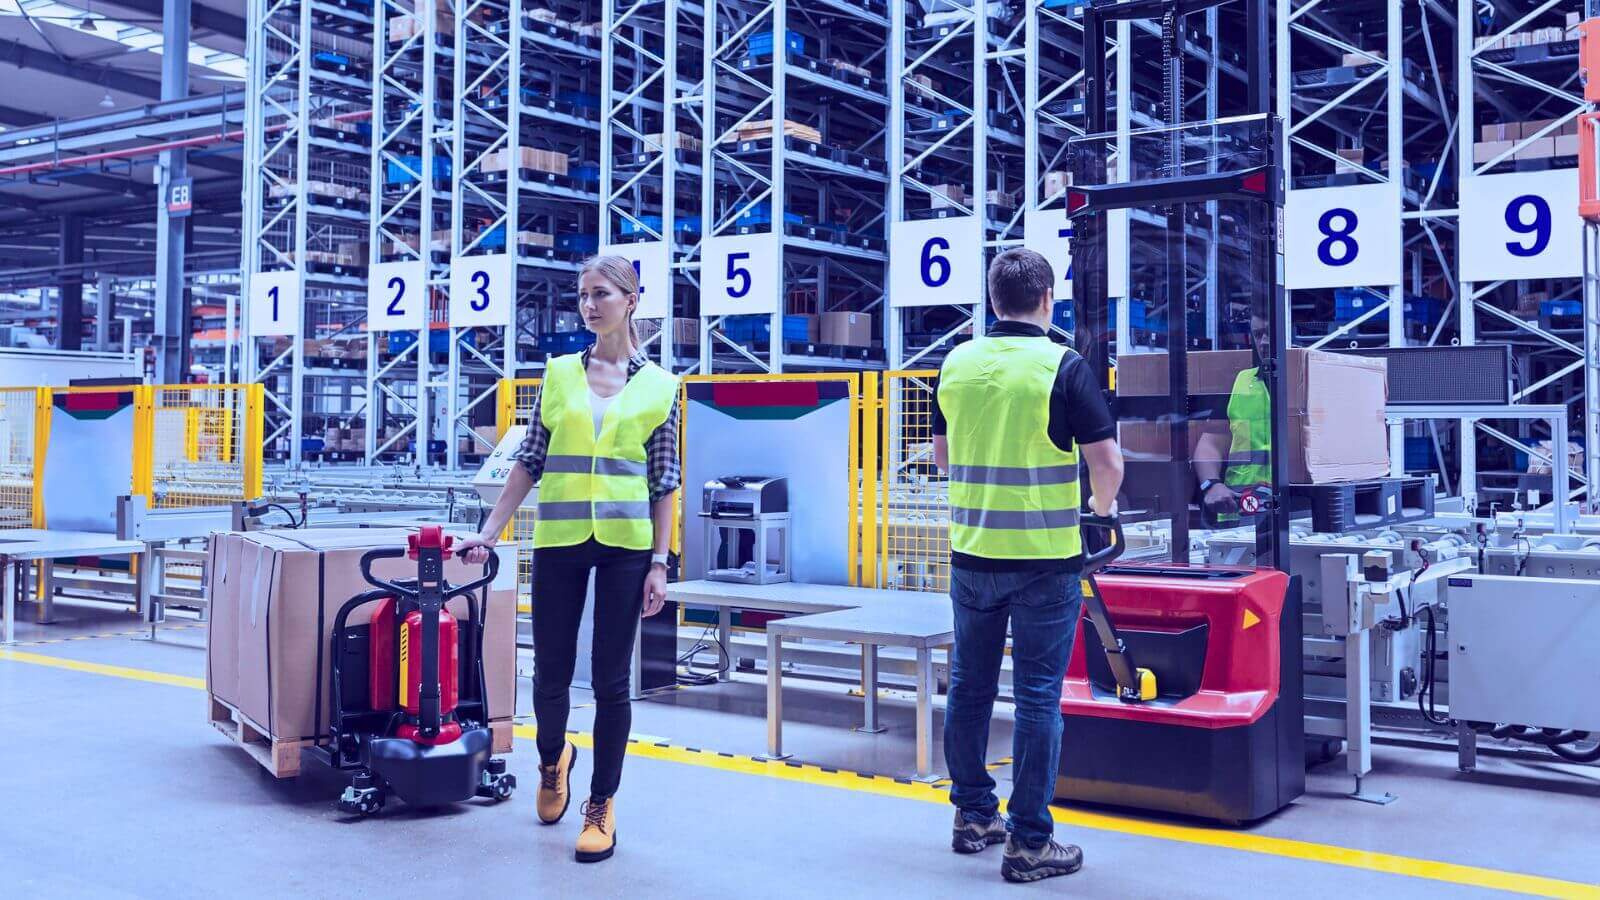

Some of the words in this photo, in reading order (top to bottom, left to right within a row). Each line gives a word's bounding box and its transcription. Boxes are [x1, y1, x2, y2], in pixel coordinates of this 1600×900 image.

[1317, 207, 1359, 266] 8
[1505, 195, 1552, 257] 9
[726, 252, 752, 298] 5
[920, 237, 951, 287] 6
[267, 287, 279, 321] 1
[386, 277, 405, 316] 2
[470, 271, 490, 311] 3
